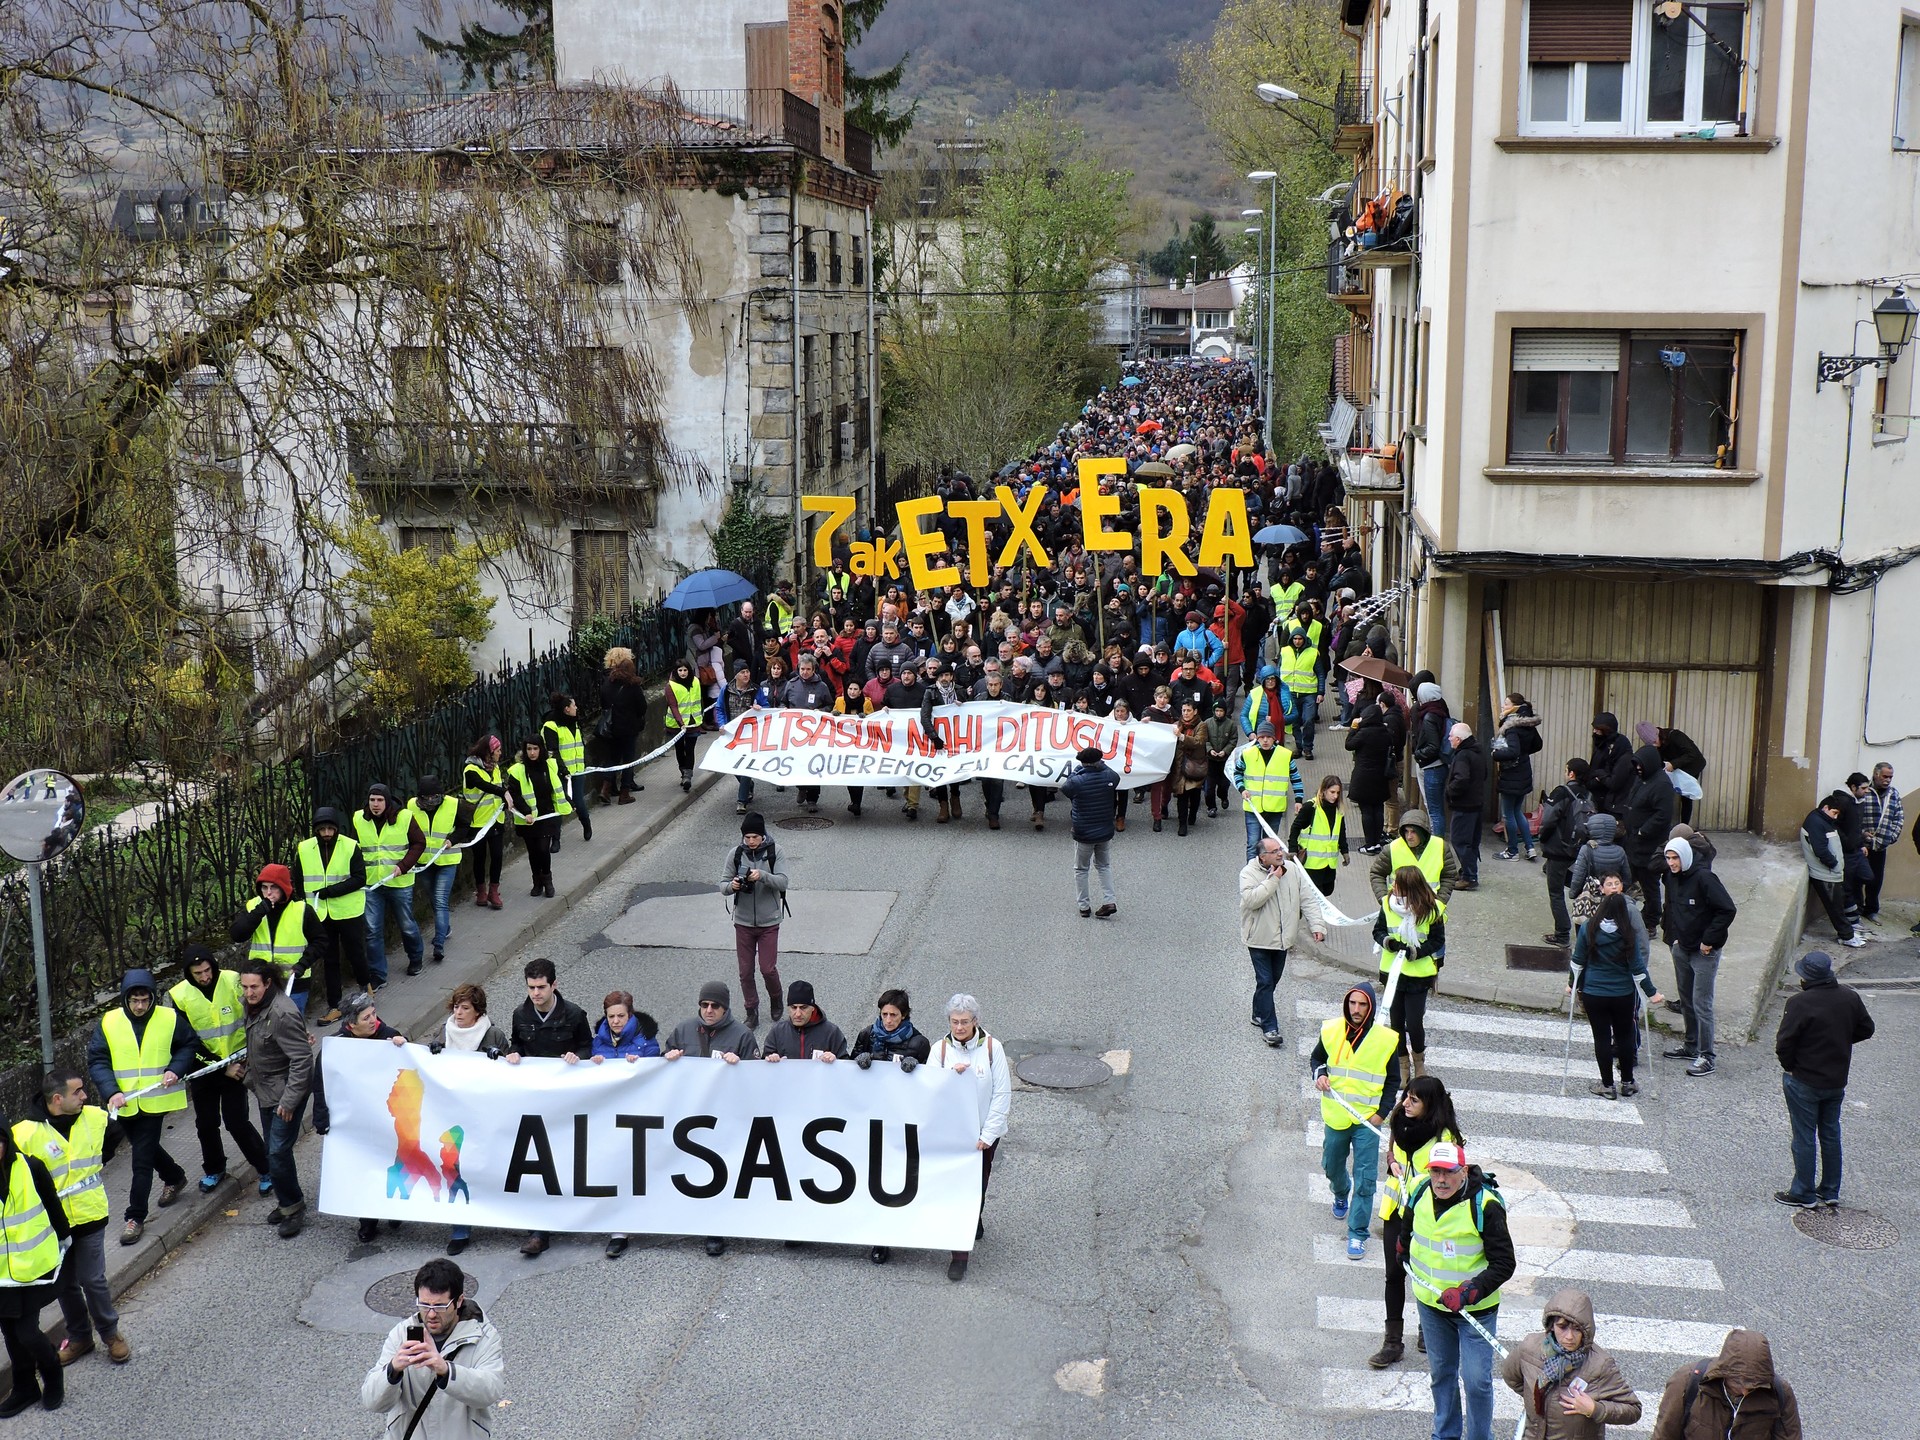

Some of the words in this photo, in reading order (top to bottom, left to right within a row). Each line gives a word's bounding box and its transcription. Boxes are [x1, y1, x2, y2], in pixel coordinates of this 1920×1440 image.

[724, 711, 894, 753] ALTSASUN
[807, 753, 947, 782] QUEREMOS
[954, 757, 990, 775] EN
[504, 1113, 919, 1208] ALTSASU
